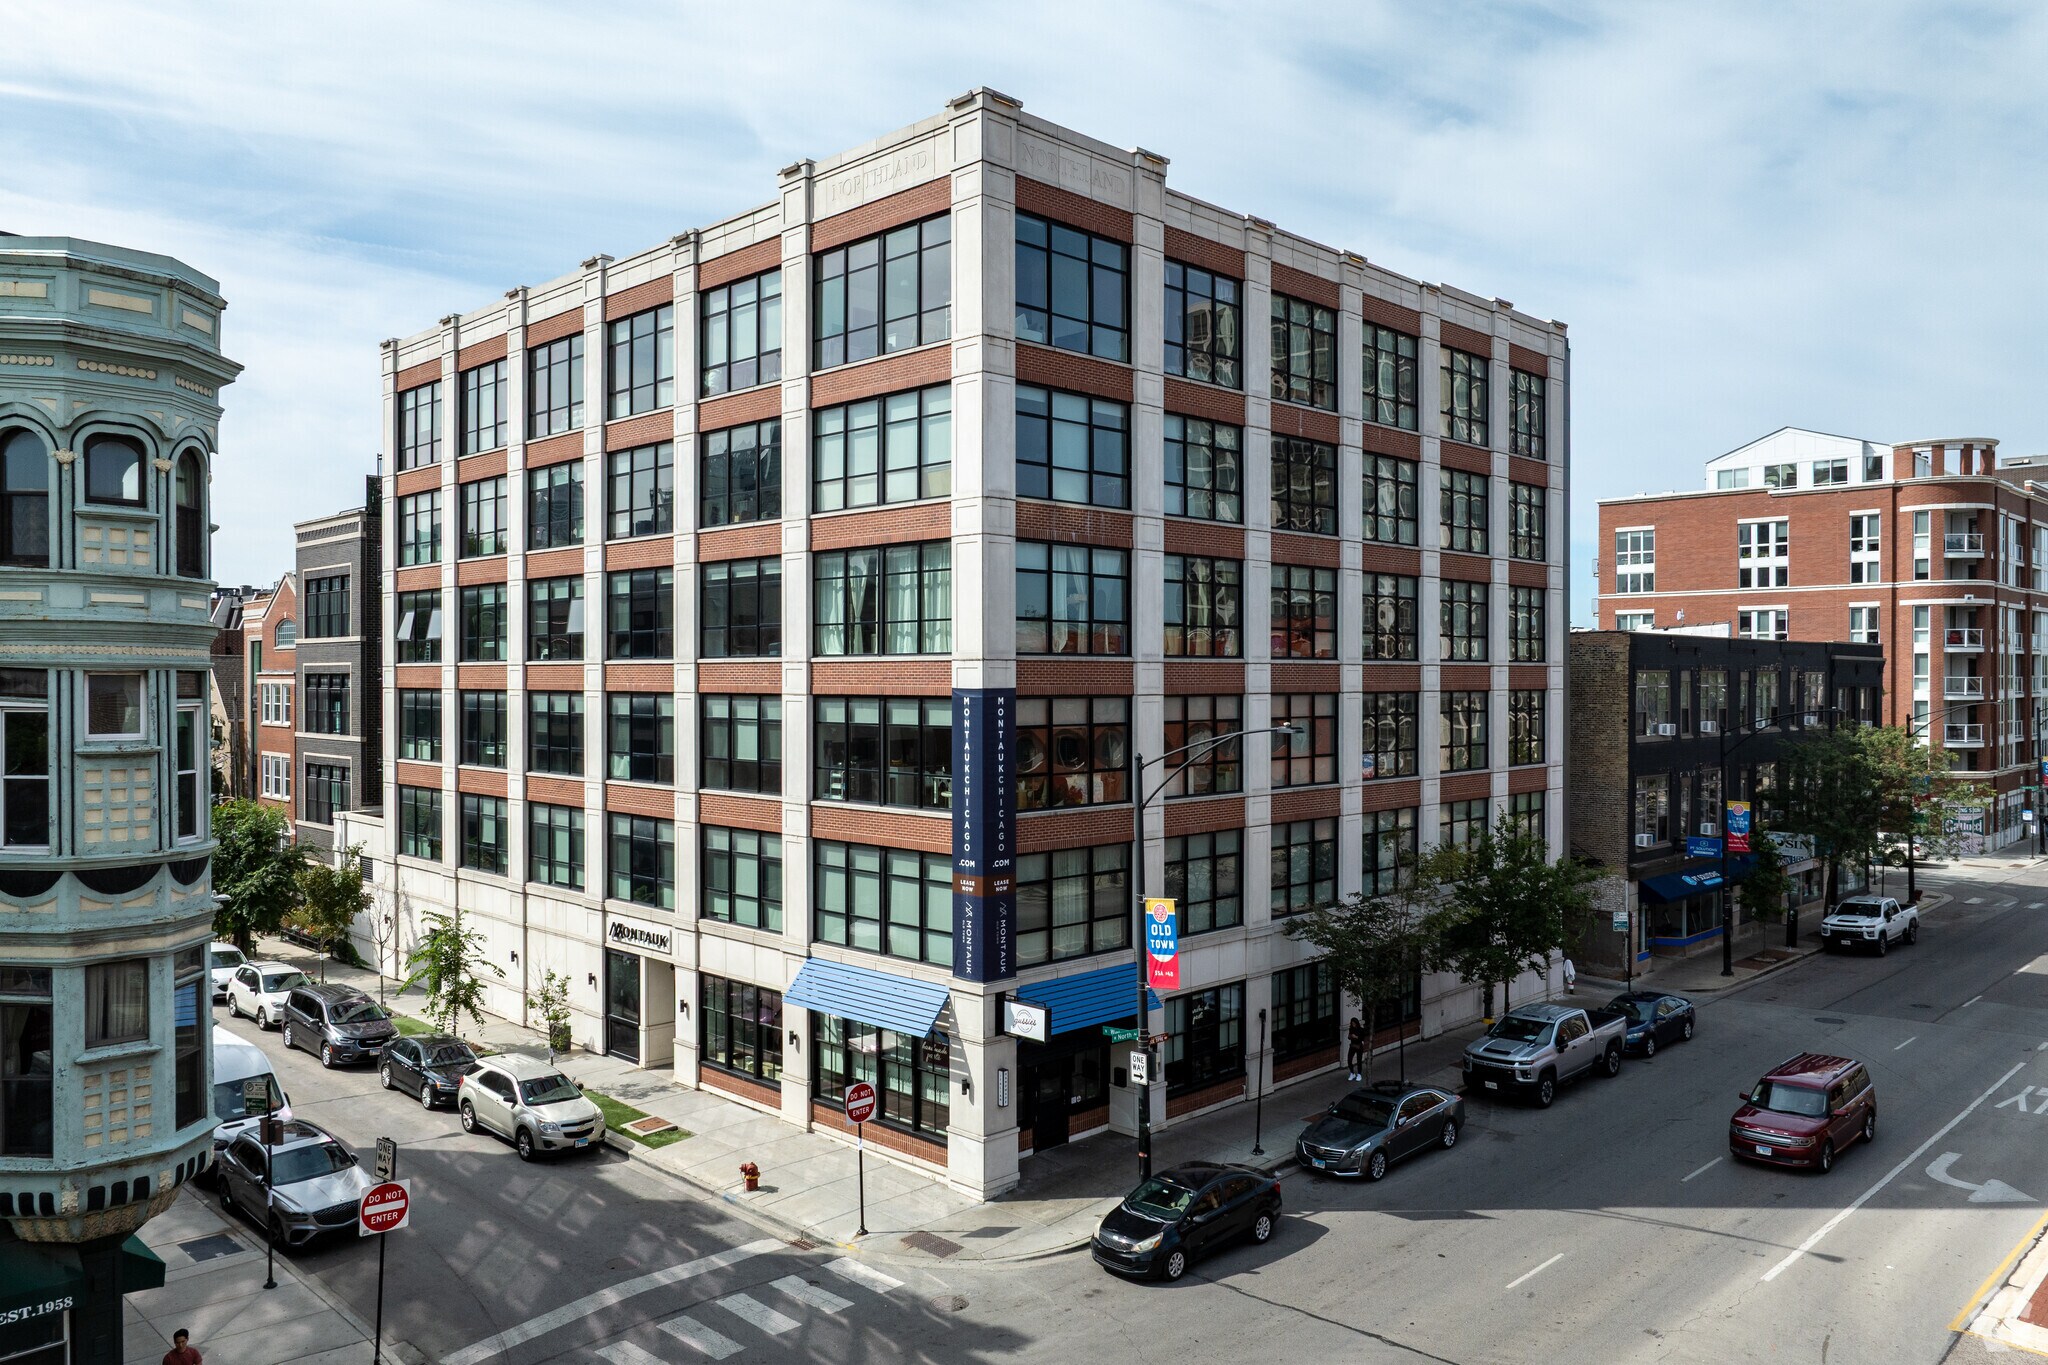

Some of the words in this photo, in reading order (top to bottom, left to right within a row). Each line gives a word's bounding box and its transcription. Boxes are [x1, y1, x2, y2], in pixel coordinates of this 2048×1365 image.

[1021, 142, 1126, 194] NORTHLAND
[831, 151, 928, 202] NORTHLAND
[963, 697, 971, 852] MONTAUKCHICAGO
[997, 697, 1005, 852] MONTAUKCHICAGO
[958, 859, 975, 867] .COM
[992, 859, 1009, 867] .COM
[960, 879, 975, 887] LEASE
[609, 921, 669, 948] MONTAUK
[1151, 924, 1172, 936] OLD
[1150, 939, 1175, 949] TOWN
[1117, 1032, 1133, 1040] North
[1132, 1055, 1145, 1065] ONE
[1132, 1063, 1145, 1072] WAY
[850, 1093, 858, 1101] DO
[860, 1088, 872, 1098] NOT
[852, 1106, 870, 1117] ENTER
[378, 1142, 392, 1155] ONE
[377, 1152, 392, 1165] WAY
[368, 1195, 381, 1204] DO
[385, 1189, 403, 1200] NOT
[370, 1211, 399, 1225] ENTER
